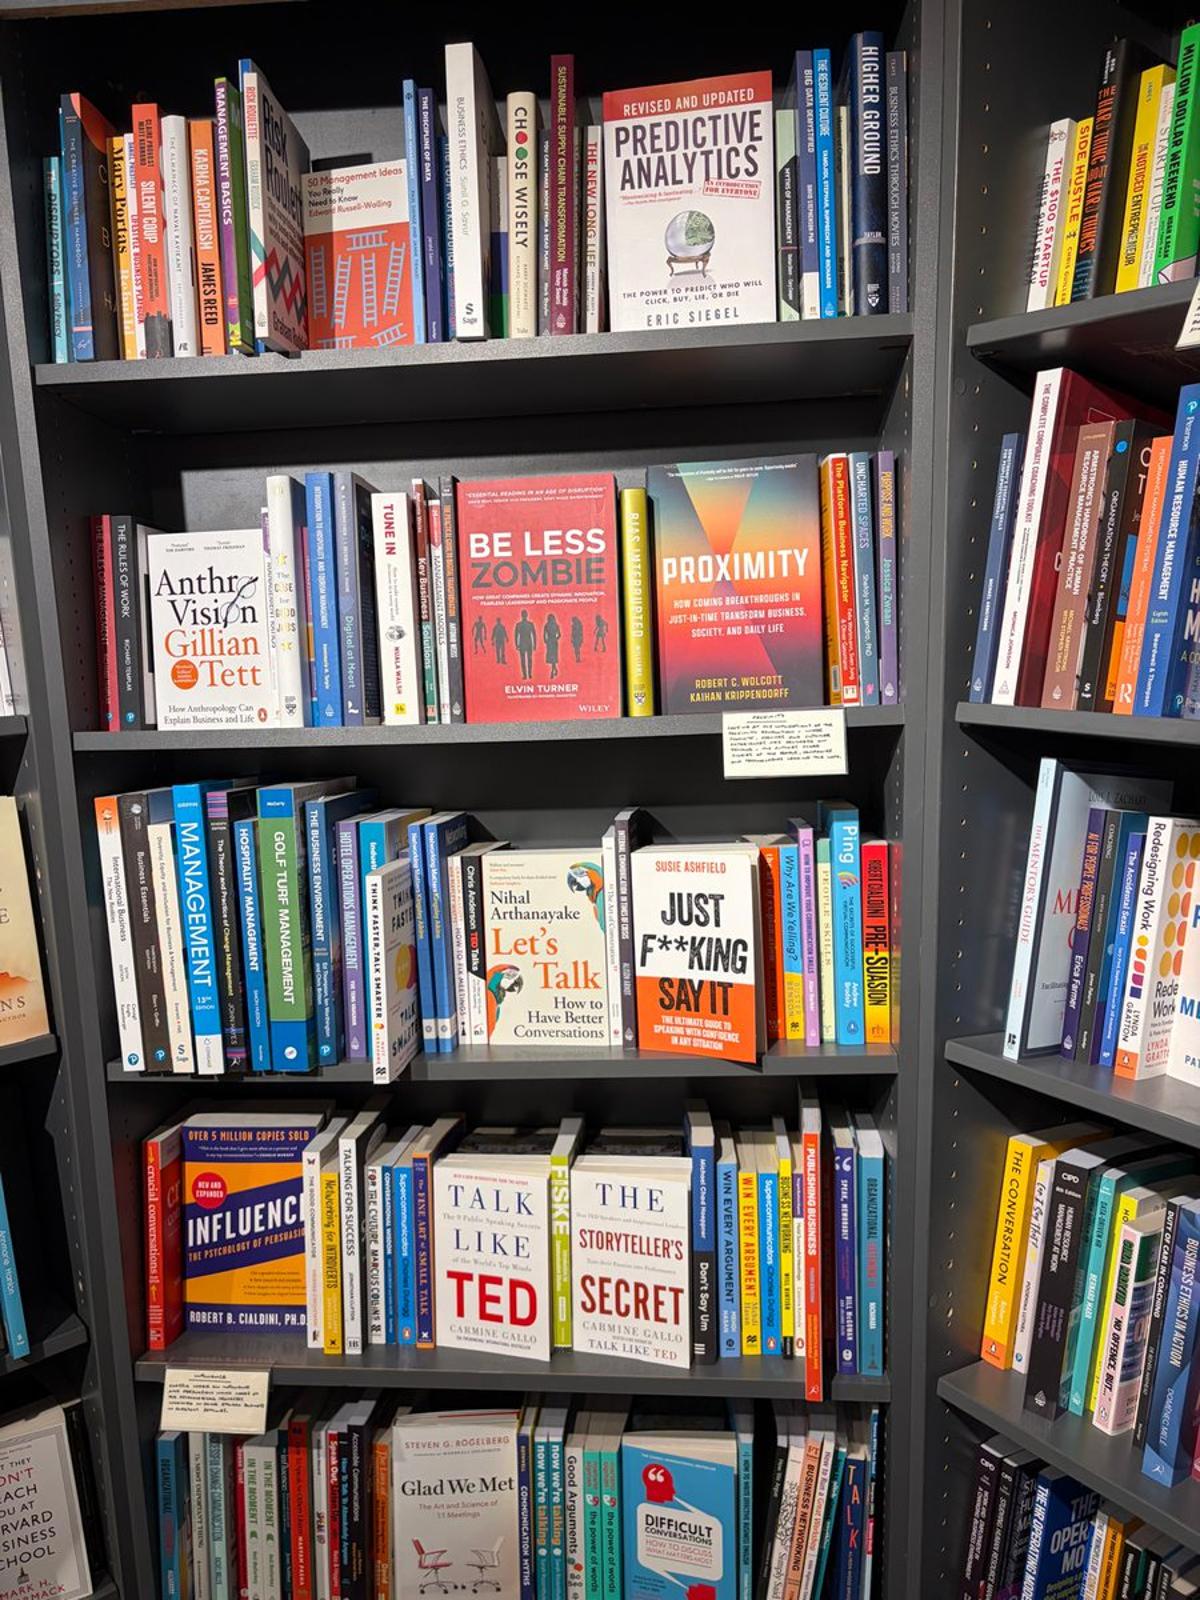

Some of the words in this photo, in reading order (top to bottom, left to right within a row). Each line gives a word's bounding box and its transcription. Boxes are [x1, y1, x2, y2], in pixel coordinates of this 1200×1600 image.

[862, 46, 880, 104] HIGHER
[1179, 43, 1195, 96] MILLION
[623, 100, 672, 117] REVISED
[675, 95, 700, 110] AND
[703, 87, 754, 106] UPDATED
[216, 87, 229, 178] MANAGEMENT
[615, 109, 763, 158] PREDICTIVE
[1171, 97, 1188, 149] DOLLAR
[863, 110, 881, 175] GROUND
[1075, 124, 1090, 161] SIDE
[307, 177, 319, 186] 50
[321, 171, 382, 186] Management
[384, 166, 403, 177] Ideas
[620, 144, 758, 192] ANALYTICS
[1051, 159, 1063, 187] THE
[1164, 149, 1182, 210] WEEKEND
[222, 181, 233, 225] BASICS
[307, 190, 320, 198] You
[321, 185, 344, 196] Really
[308, 199, 326, 207] Need
[337, 194, 359, 203] Know
[1047, 188, 1059, 223] $100
[1068, 162, 1087, 223] HUSTLE
[308, 207, 336, 218] Edward
[337, 198, 392, 213] Russell-Walling
[1040, 225, 1055, 287] STARTUP
[201, 262, 215, 295] JAMES
[622, 291, 637, 299] THE
[639, 289, 668, 297] POWER
[671, 287, 682, 295] TO
[685, 285, 717, 294] PREDICT
[720, 281, 741, 289] WHO
[744, 279, 763, 287] WILL
[204, 298, 218, 325] REED
[645, 297, 669, 305] CLICK,
[712, 291, 723, 299] OR
[726, 290, 740, 298] DIE
[646, 313, 680, 327] ERIC
[689, 308, 740, 323] SIEGEL
[1175, 460, 1188, 493] HUMAN
[383, 504, 396, 539] TUNE
[1168, 494, 1183, 538] RESOURCE
[117, 524, 126, 541] THE
[469, 532, 512, 558] BE
[525, 528, 606, 557] LESS
[118, 544, 128, 573] RULES
[384, 541, 396, 555] IN
[120, 574, 128, 587] OF
[471, 557, 606, 588] ZOMBIE
[663, 548, 809, 585] PROXIMITY
[1158, 541, 1176, 600] MANAGEMENT
[121, 589, 130, 618] WORK
[673, 599, 691, 609] HOW
[693, 596, 723, 608] COMING
[725, 594, 789, 607] BREAKTHROUGHS
[792, 593, 800, 602] IN
[669, 612, 718, 624] JUST-IN-TIME
[720, 610, 765, 622] TRANSFORM
[726, 626, 742, 635] AND
[745, 624, 766, 635] DAILY
[768, 623, 784, 633] LIFE
[164, 629, 260, 658] Gillian
[199, 660, 262, 687] Tett
[695, 678, 728, 689] ROBERT
[731, 677, 739, 687] C.
[741, 675, 783, 687] WOLCOTT
[504, 685, 535, 694] ELVIN
[537, 684, 578, 693] TURNER
[690, 691, 723, 703] KAIHAN
[725, 688, 789, 700] KRIPPENDORFF
[164, 716, 191, 725] Explain
[192, 715, 220, 724] Business
[222, 715, 237, 723] and
[239, 715, 254, 723] Life
[168, 705, 184, 713] How
[186, 704, 235, 714] Anthropology
[237, 704, 254, 712] Can
[578, 704, 610, 713] WILEY
[274, 832, 286, 868] GOLF
[838, 825, 858, 864] Ping
[1141, 822, 1167, 895] Redesigning
[655, 860, 682, 873] SUSIE
[684, 861, 726, 874] ASHFIELD
[784, 855, 794, 880] Why
[867, 859, 885, 883] ROBERT
[276, 870, 289, 904] TURF
[490, 890, 531, 905] Nihal
[786, 881, 796, 900] Are
[866, 883, 885, 918] CIALDINI
[180, 822, 212, 988] MANAGEMENT
[491, 905, 580, 924] Arthanayake
[660, 892, 725, 928] JUST
[787, 900, 796, 917] We
[1139, 891, 1156, 931] Work
[492, 928, 559, 956] Let's
[786, 917, 798, 962] Yelling?
[278, 907, 294, 1004] MANAGEMENT
[865, 925, 888, 1006] PRE-SUASION
[533, 960, 601, 990] Talk
[553, 997, 585, 1010] How
[589, 998, 603, 1009] to
[658, 977, 707, 1014] SAY
[710, 982, 733, 1016] IT
[513, 1025, 605, 1039] Conversations
[528, 1011, 562, 1024] Have
[564, 1011, 604, 1024] Better
[188, 1130, 209, 1142] OVER
[211, 1130, 217, 1140] 5
[220, 1130, 254, 1141] MILLION
[257, 1131, 285, 1141] COPIES
[288, 1130, 309, 1141] SOLD
[1012, 1151, 1023, 1176] THE
[723, 1170, 732, 1195] WIN
[447, 1184, 534, 1216] TALK
[553, 1165, 568, 1236] FISKE
[595, 1183, 664, 1213] THE
[723, 1200, 733, 1236] EVERY
[997, 1178, 1020, 1286] CONVERSATION
[454, 1228, 531, 1259] LIKE
[579, 1229, 684, 1261] STORYTELLER'S
[724, 1240, 734, 1303] ARGUMENT
[447, 1271, 538, 1328] TED
[580, 1274, 684, 1326] SECRET
[189, 1311, 223, 1323] ROBERT
[226, 1313, 236, 1324] B.
[239, 1312, 281, 1325] CIALDINI,
[582, 1320, 639, 1336] CARMINE
[643, 1329, 683, 1344] GALLO
[449, 1324, 499, 1340] CARMINE
[502, 1329, 538, 1344] GALLO
[588, 1338, 619, 1351] TALK
[622, 1343, 650, 1356] LIKE
[653, 1349, 678, 1361] TED
[405, 1440, 440, 1449] STEVEN
[442, 1439, 453, 1448] G.
[455, 1436, 510, 1447] ROGELBERG
[401, 1478, 444, 1497] Glad
[446, 1479, 476, 1494] We
[480, 1476, 514, 1493] Met
[568, 1455, 577, 1489] Good
[799, 1463, 816, 1511] BUSINESS
[567, 1490, 578, 1555] Arguments
[644, 1514, 713, 1538] DIFFICULT
[644, 1527, 713, 1546] CONVERSATIONS
[791, 1511, 811, 1572] NETWORKING
